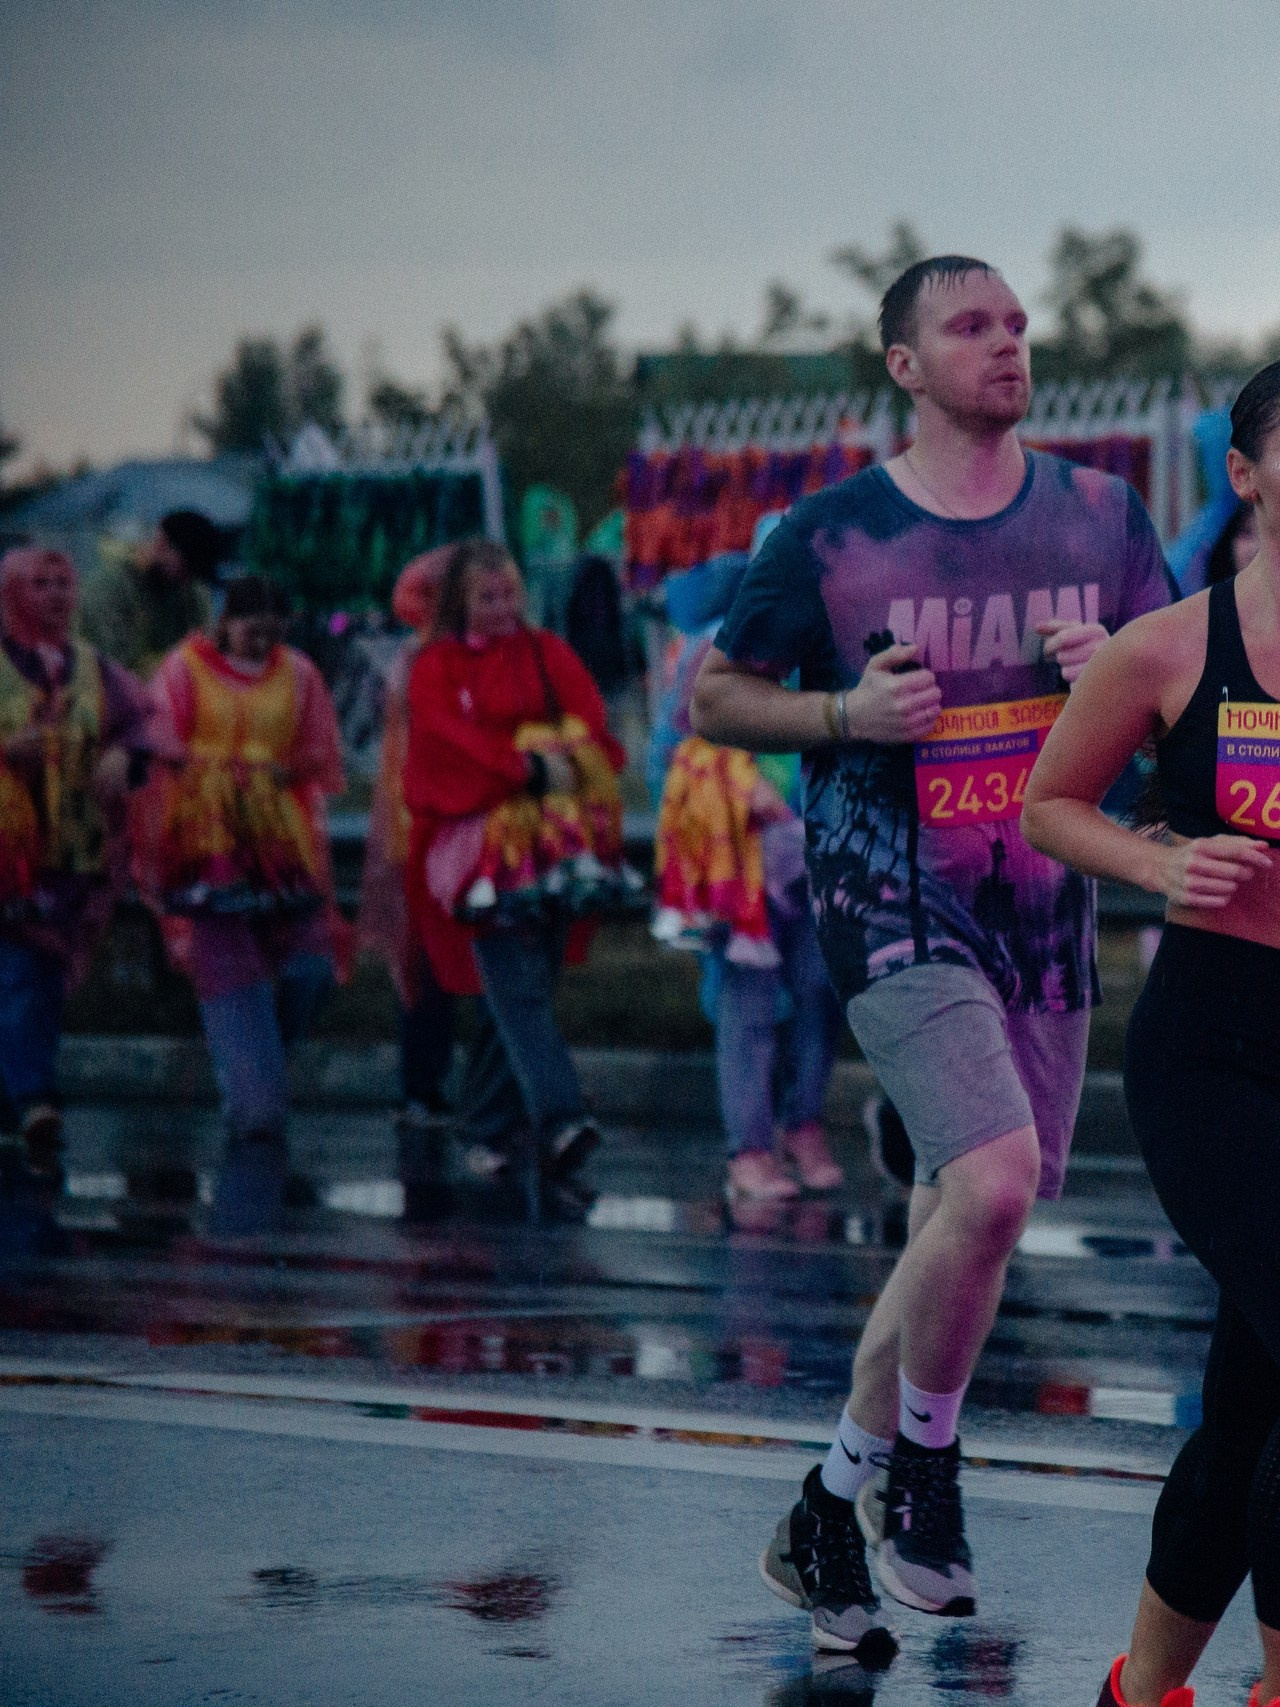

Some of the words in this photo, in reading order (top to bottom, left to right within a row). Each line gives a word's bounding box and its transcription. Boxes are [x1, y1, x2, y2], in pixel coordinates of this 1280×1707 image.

[934, 709, 1000, 735] ОЧНОЙ
[921, 748, 929, 759] В
[931, 744, 981, 759] СТОЛИЦЕ
[984, 737, 1031, 754] ЗАКАТОВ
[1227, 744, 1235, 756] В
